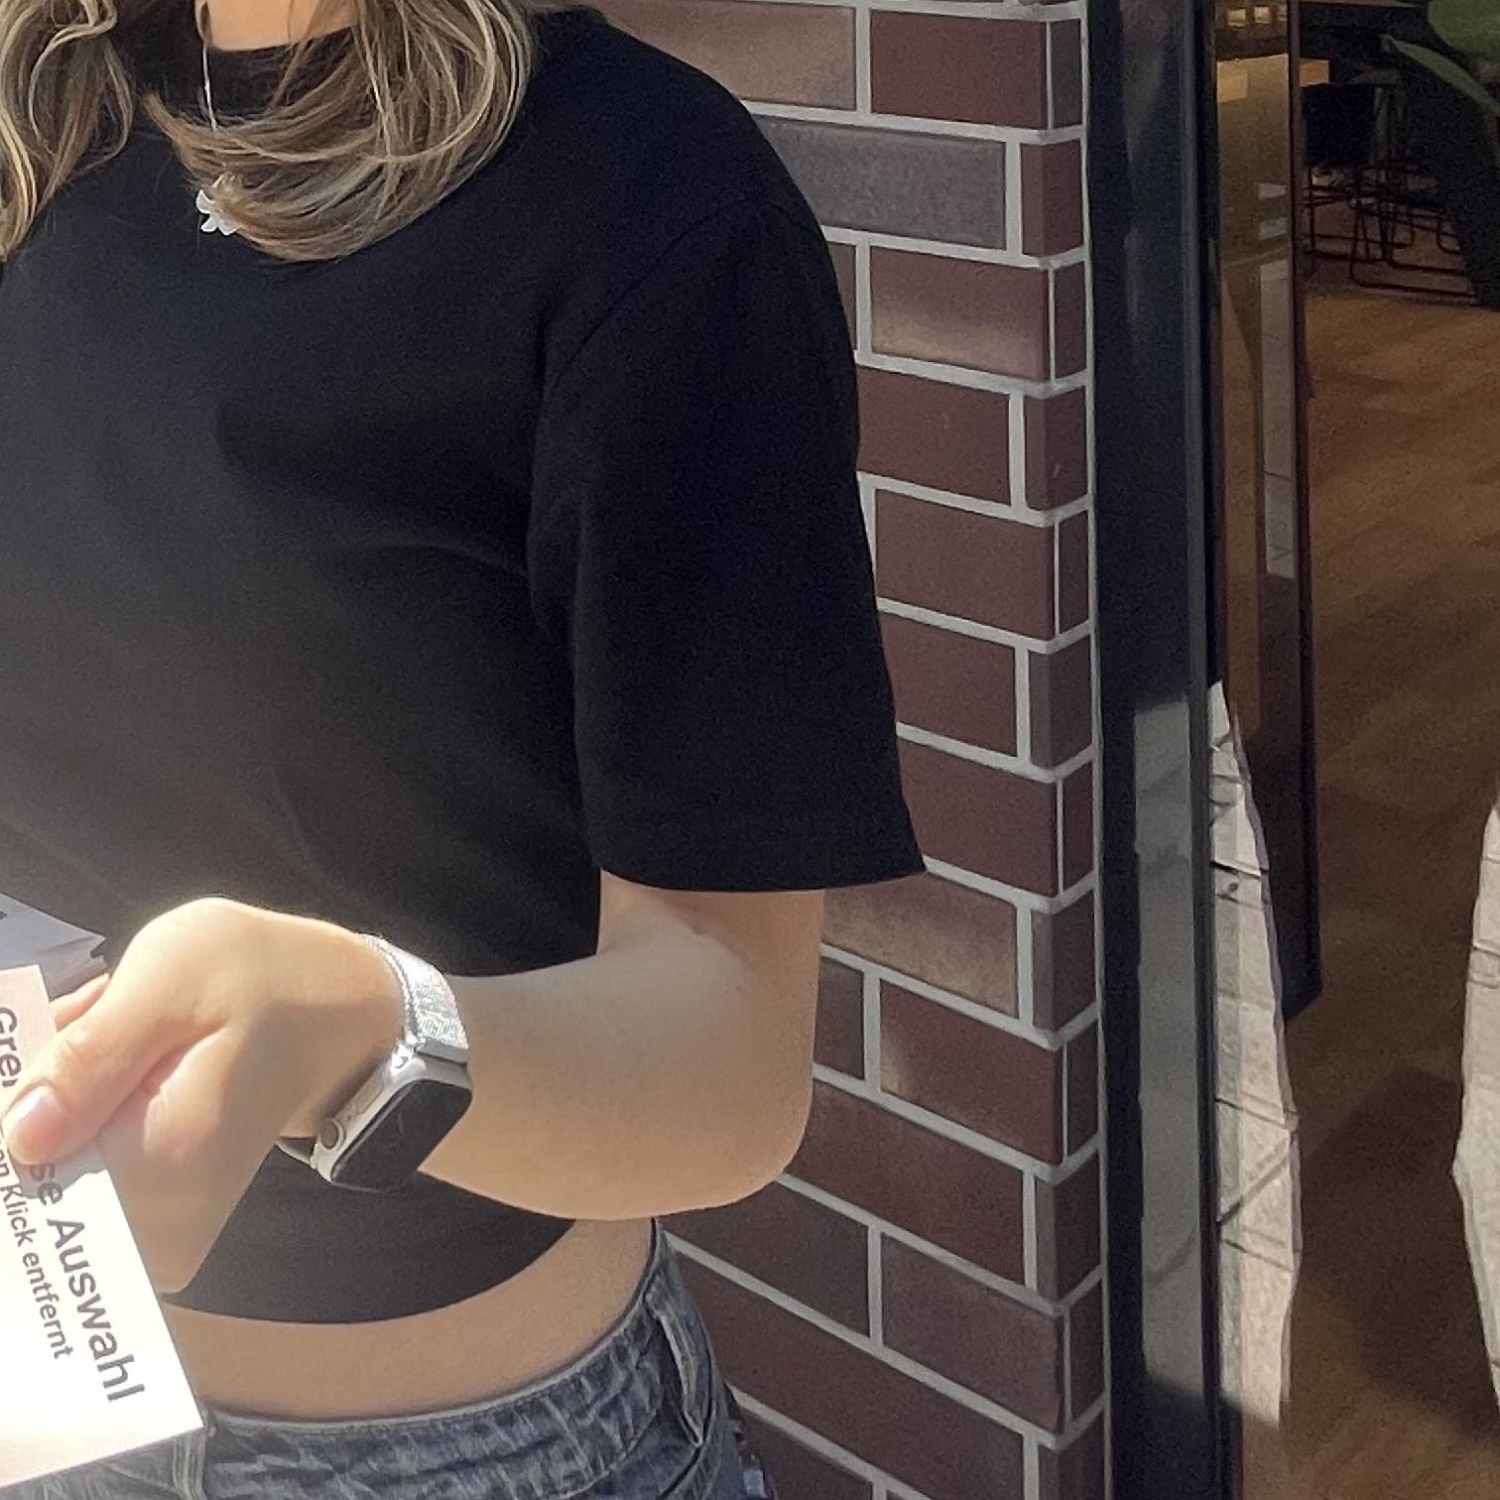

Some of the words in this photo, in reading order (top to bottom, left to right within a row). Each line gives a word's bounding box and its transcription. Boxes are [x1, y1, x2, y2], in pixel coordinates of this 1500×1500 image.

[0, 1182, 37, 1248] Klick
[22, 1252, 74, 1360] entfernt
[46, 1218, 145, 1402] Auswahl
